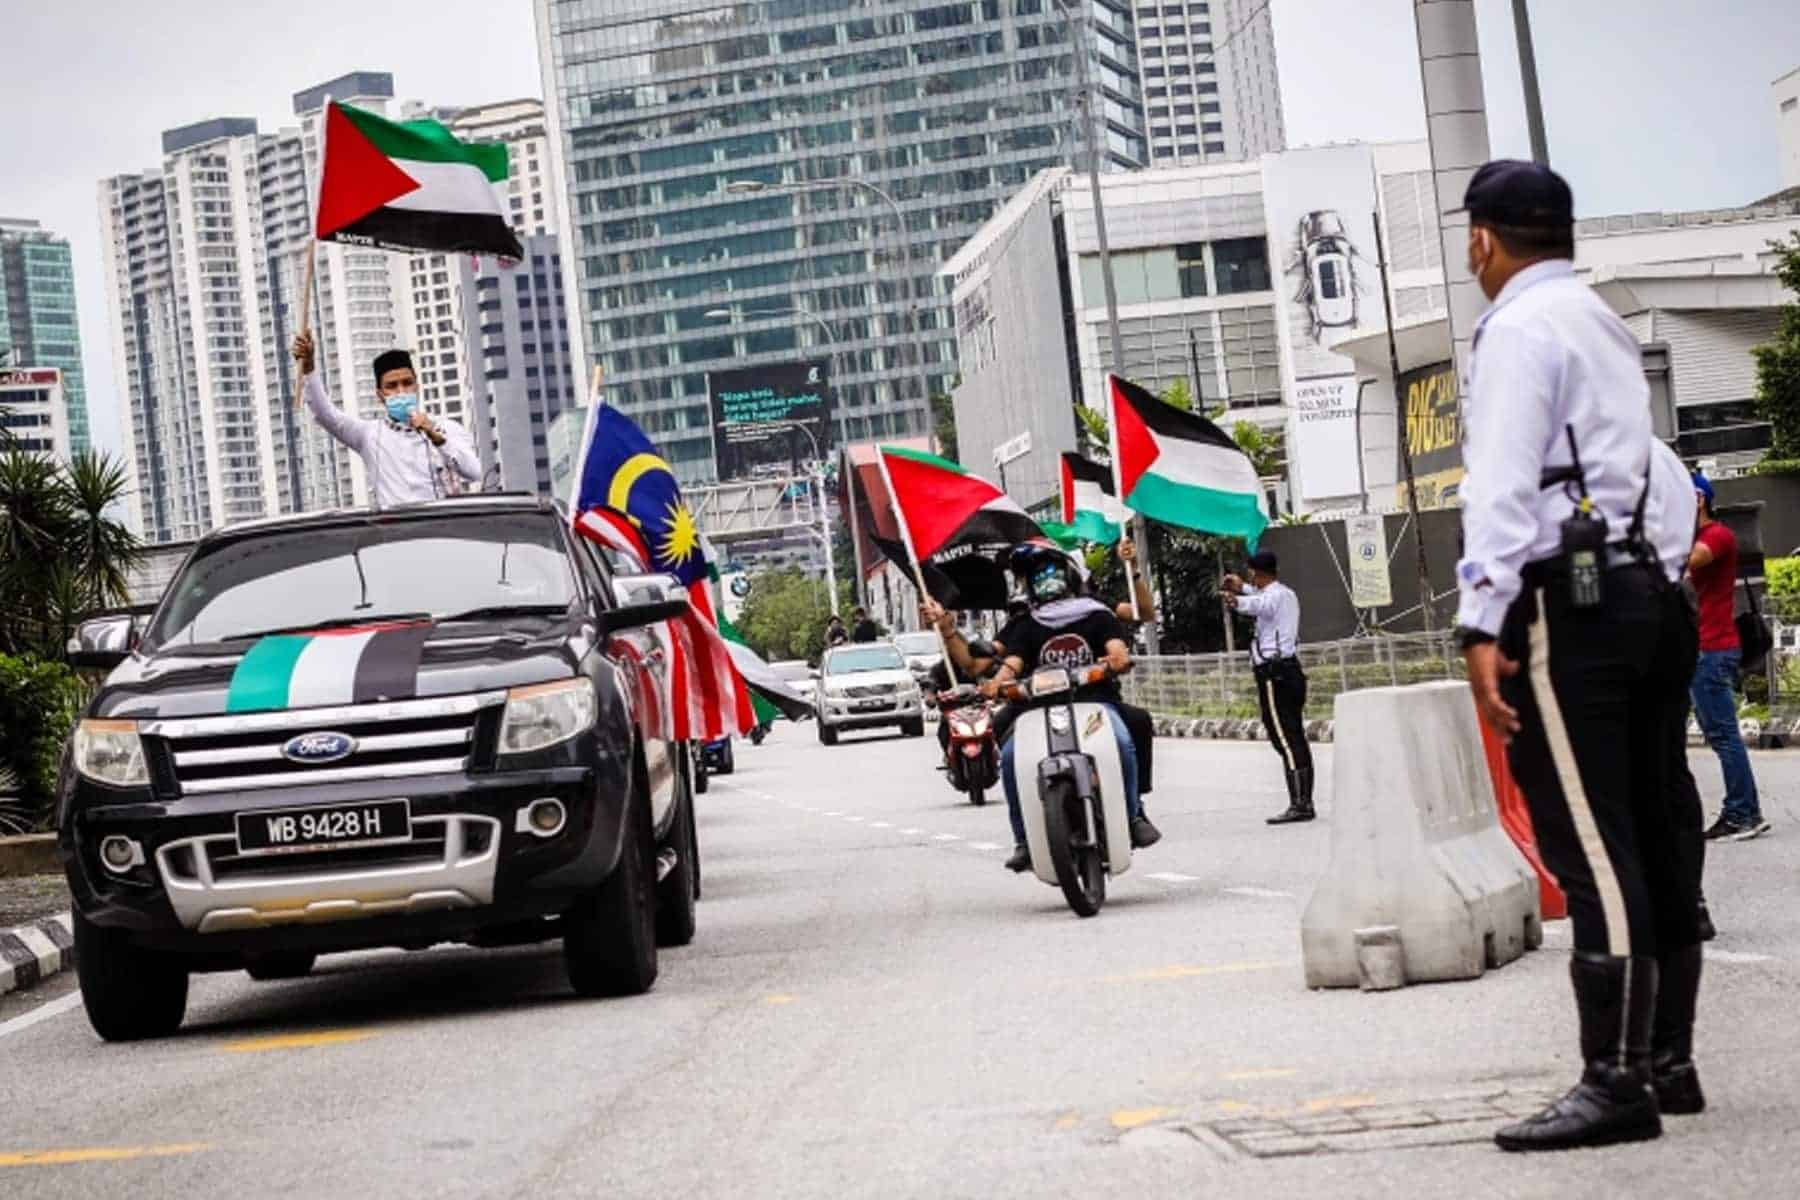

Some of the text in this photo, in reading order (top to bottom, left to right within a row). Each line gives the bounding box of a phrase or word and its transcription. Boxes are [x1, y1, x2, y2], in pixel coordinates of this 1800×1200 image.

[299, 736, 338, 755] Ford
[267, 808, 381, 843] WB 9428 H
